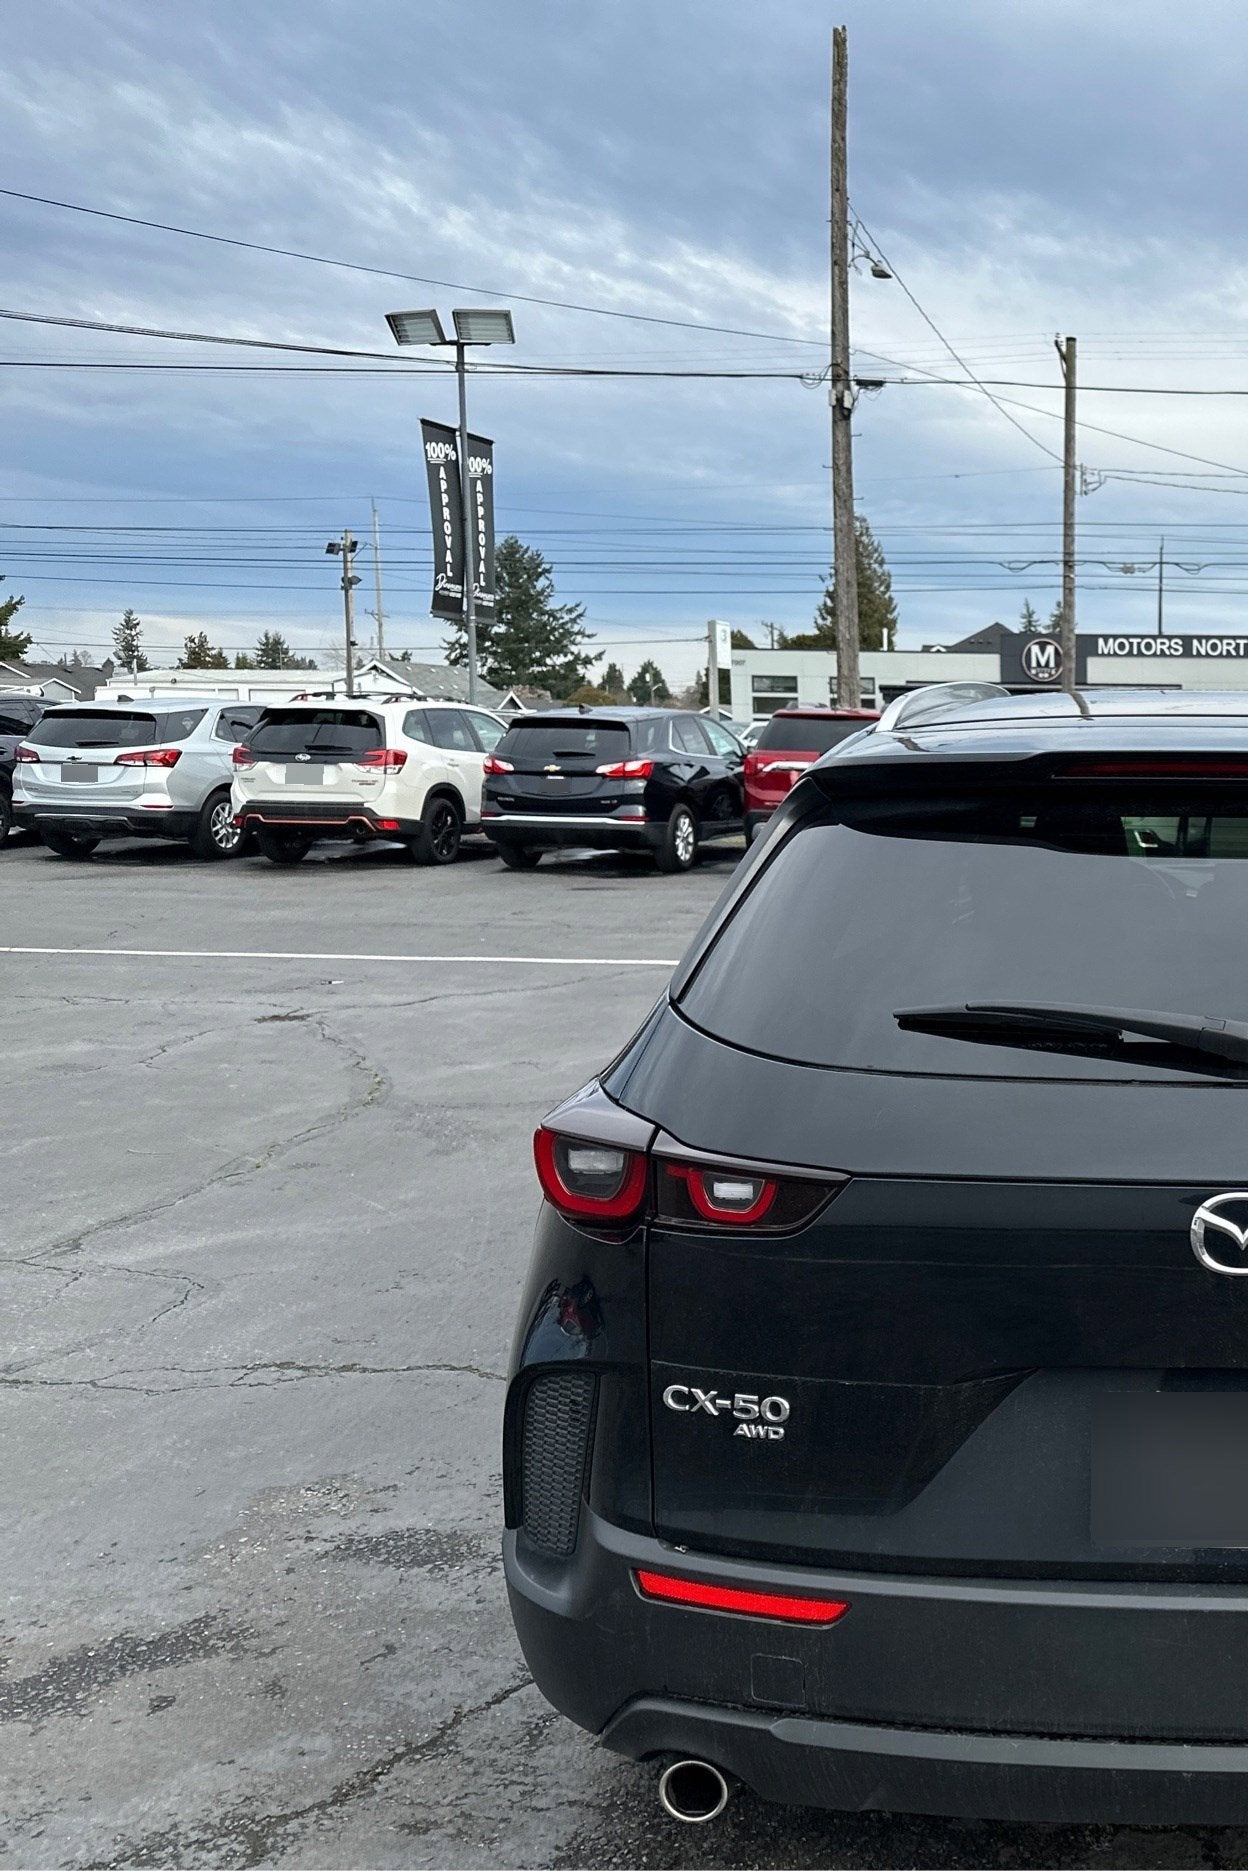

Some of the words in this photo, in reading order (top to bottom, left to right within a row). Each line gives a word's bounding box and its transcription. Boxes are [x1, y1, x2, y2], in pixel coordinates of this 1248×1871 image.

[426, 441, 456, 461] 100%
[467, 456, 492, 475] 00%
[439, 466, 453, 577] APPROVAL
[475, 479, 486, 587] APPROVAL
[1031, 644, 1055, 668] M
[1097, 637, 1183, 655] MOTORS
[662, 1384, 790, 1423] CX-50
[732, 1423, 785, 1440] AWD
